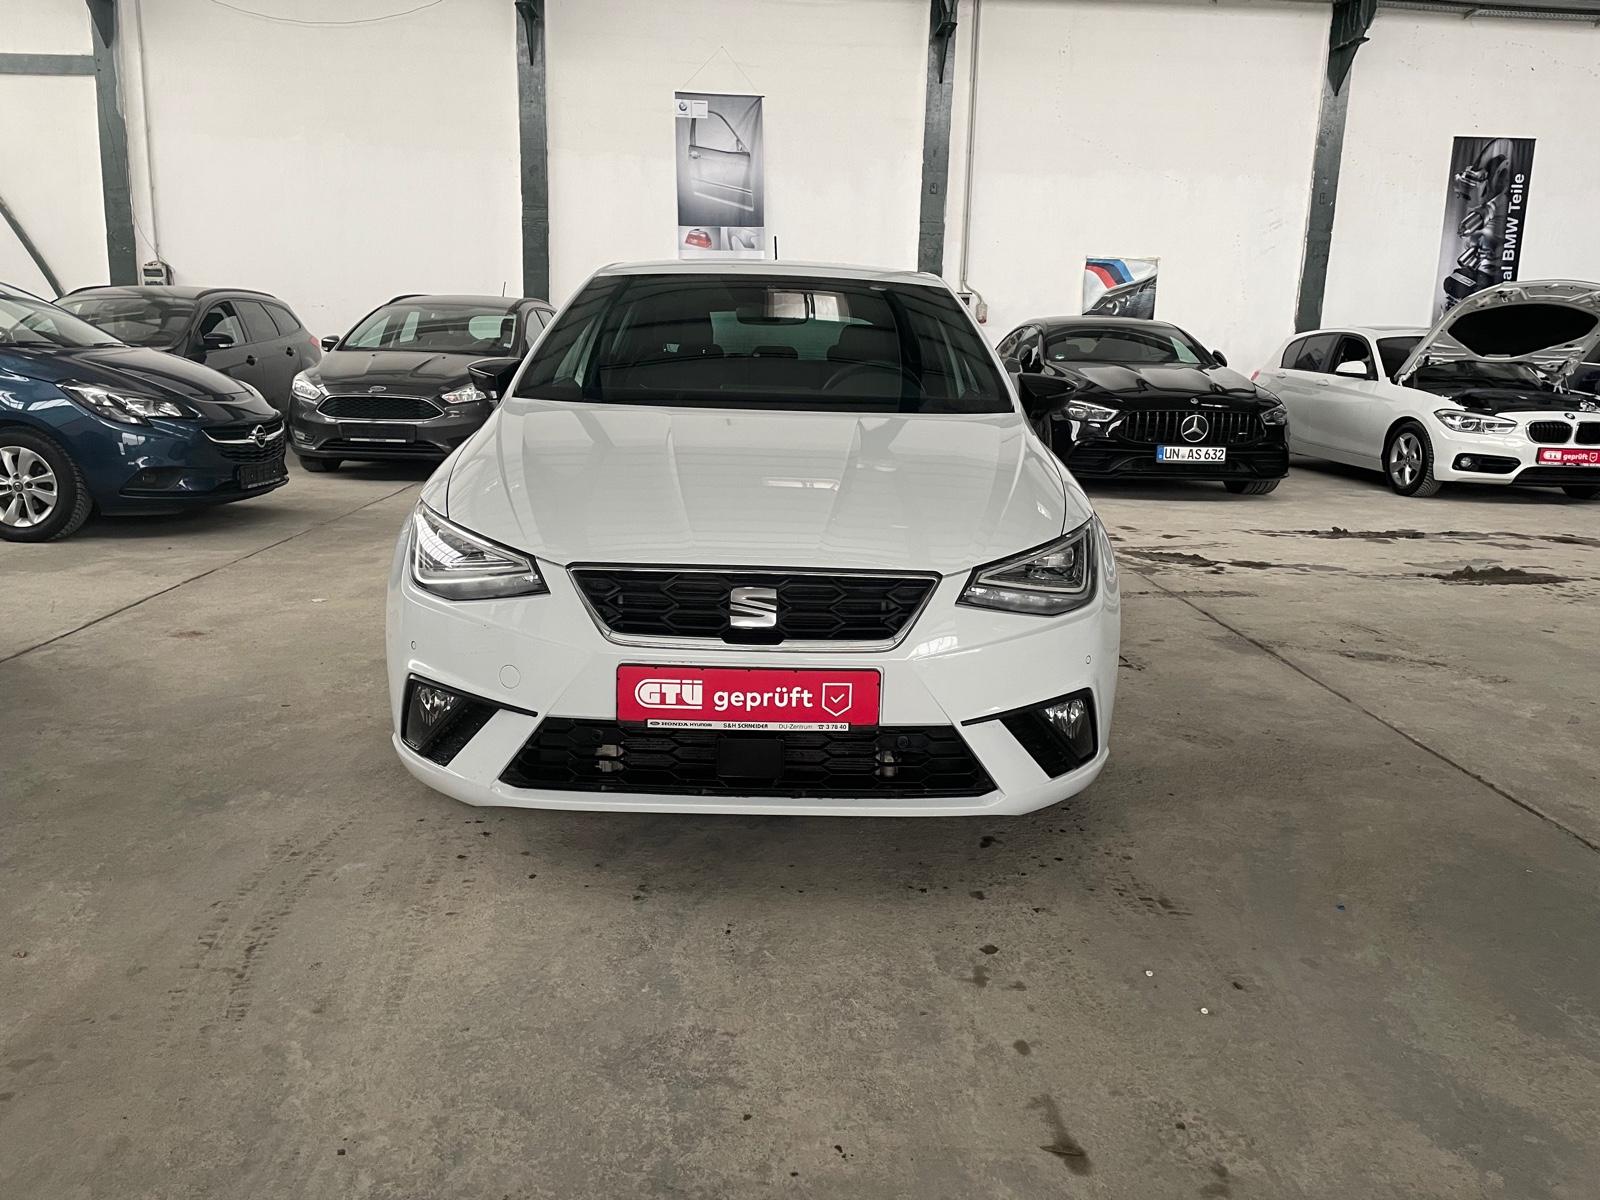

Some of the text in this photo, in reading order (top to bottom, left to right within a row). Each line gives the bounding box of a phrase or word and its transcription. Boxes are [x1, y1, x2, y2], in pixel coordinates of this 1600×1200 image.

[1507, 173, 1525, 214] Teile
[1502, 217, 1519, 261] BMW
[1164, 448, 1224, 460] UN AS 632
[1563, 453, 1588, 461] geprüft
[635, 679, 814, 712] GTÜ geprüft
